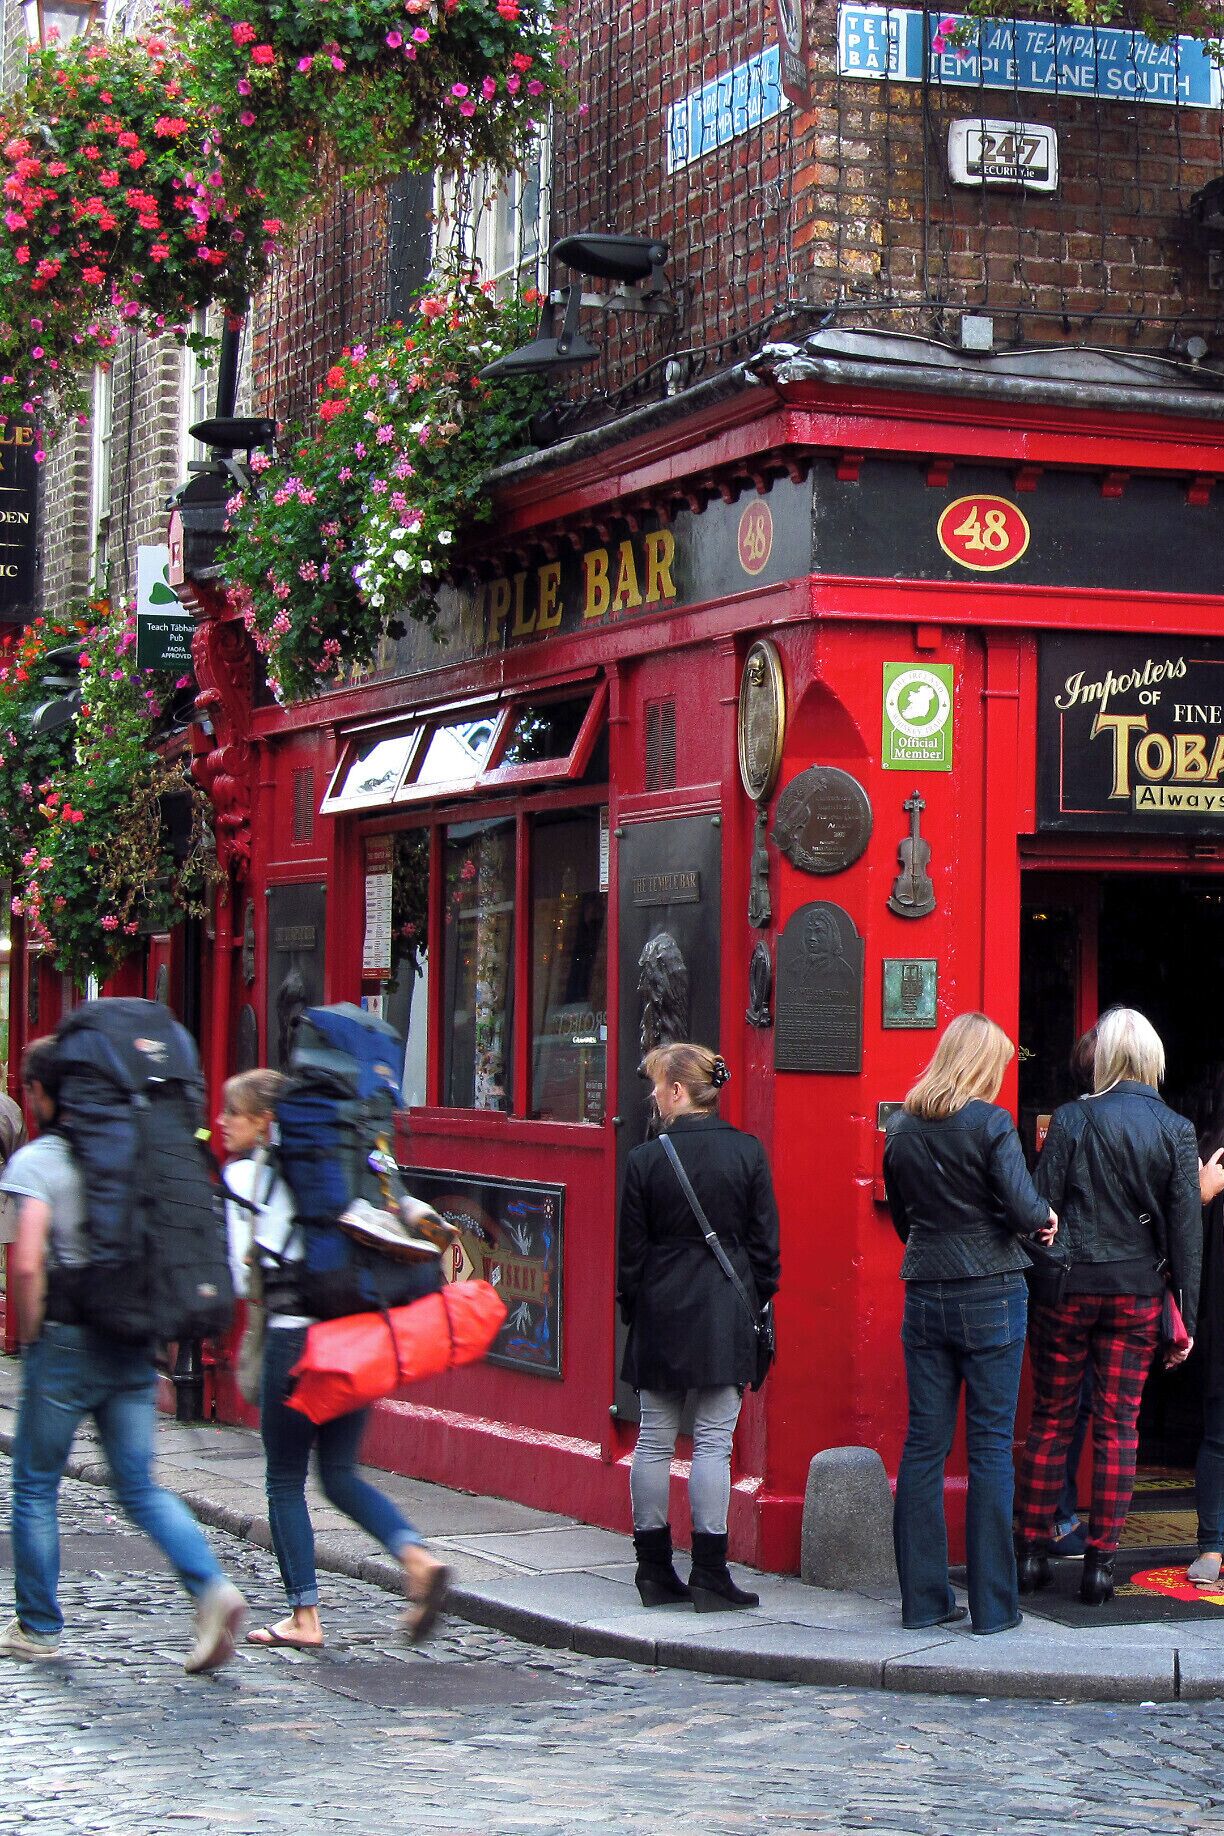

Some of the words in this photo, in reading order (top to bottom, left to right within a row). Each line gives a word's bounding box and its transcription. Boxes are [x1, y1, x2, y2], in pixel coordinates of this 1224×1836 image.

[988, 29, 1015, 50] AN
[1025, 32, 1117, 61] TEAMPAILL
[848, 51, 897, 70] BAR
[1031, 61, 1098, 88] LANE
[1107, 68, 1190, 96] SOUTH
[744, 514, 766, 560] 48
[953, 506, 1009, 551] 48
[584, 529, 677, 620] BAR
[147, 622, 168, 631] Teach
[1054, 656, 1187, 712] Importers
[1138, 690, 1161, 706] OF
[1173, 704, 1222, 724] FINE
[894, 748, 941, 759] Member
[898, 737, 938, 748] Official
